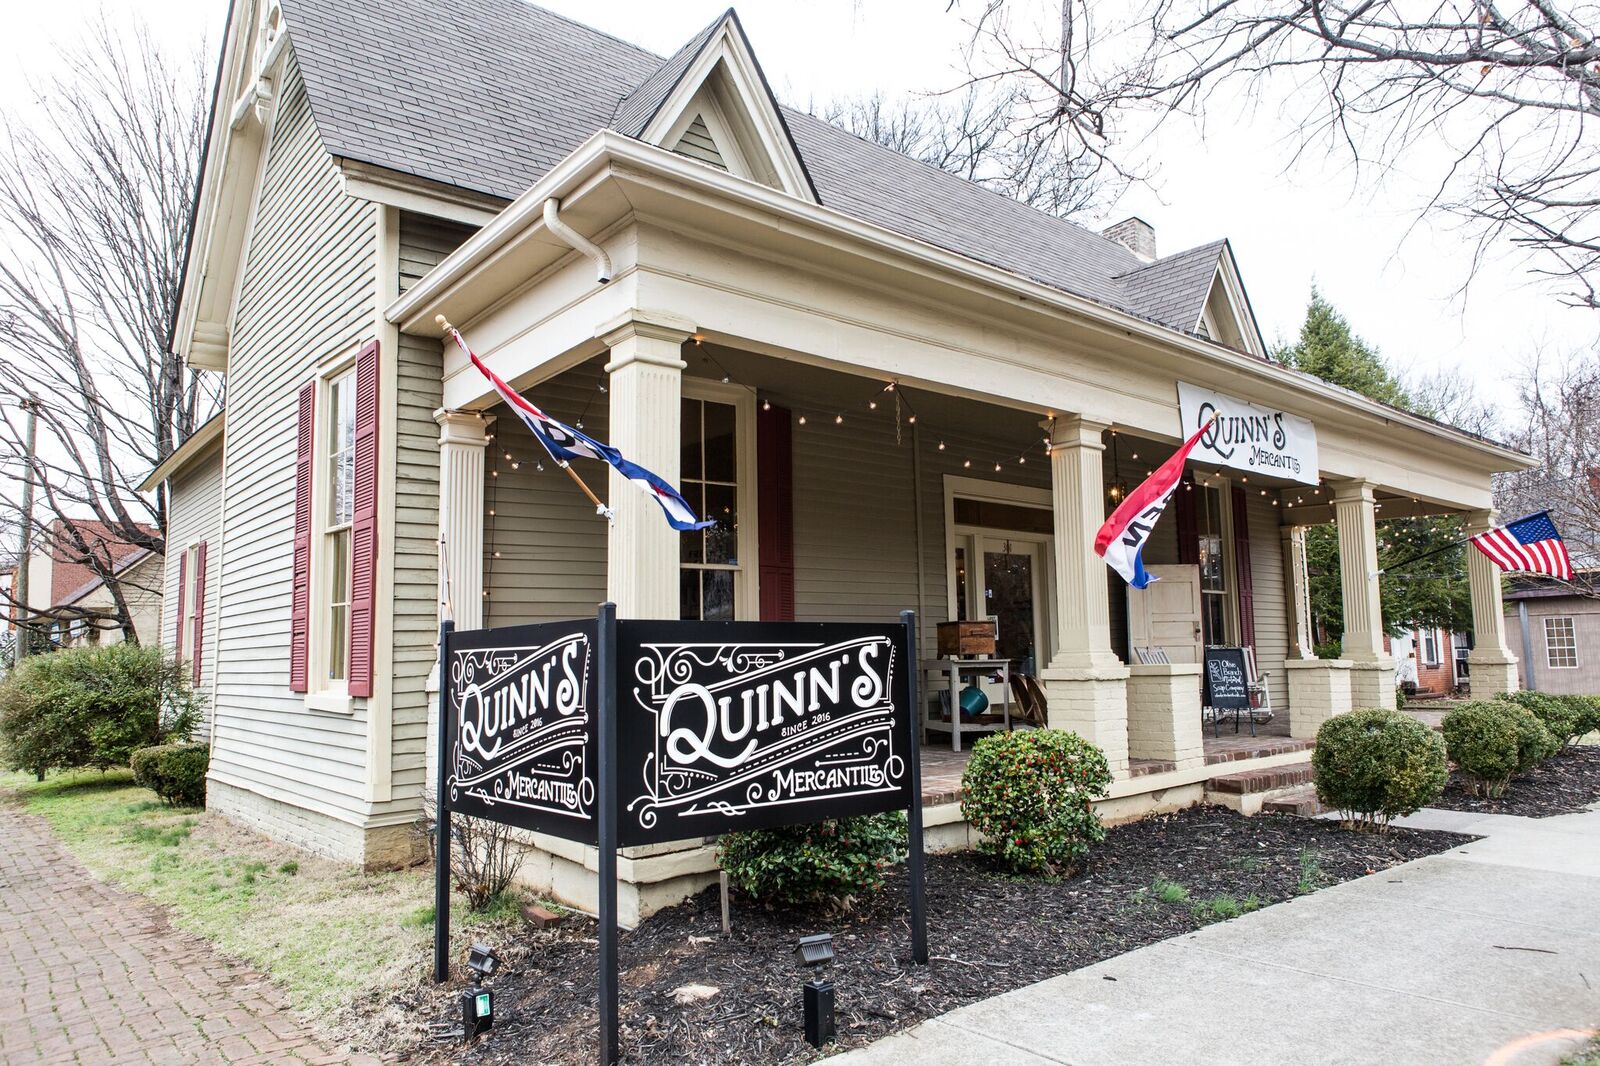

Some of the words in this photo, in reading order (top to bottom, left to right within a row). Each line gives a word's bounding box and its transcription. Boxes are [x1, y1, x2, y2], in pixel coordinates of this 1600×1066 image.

[1198, 402, 1286, 459] QUINN'S
[460, 641, 580, 760] QUINN'S
[660, 642, 883, 768] QUINN'S
[513, 725, 529, 738] SINCE
[530, 717, 543, 730] 2016
[781, 720, 808, 737] SINCE
[811, 712, 831, 725] 2016
[504, 769, 578, 809] MERCANTILE
[768, 764, 885, 802] MERCANTILE
